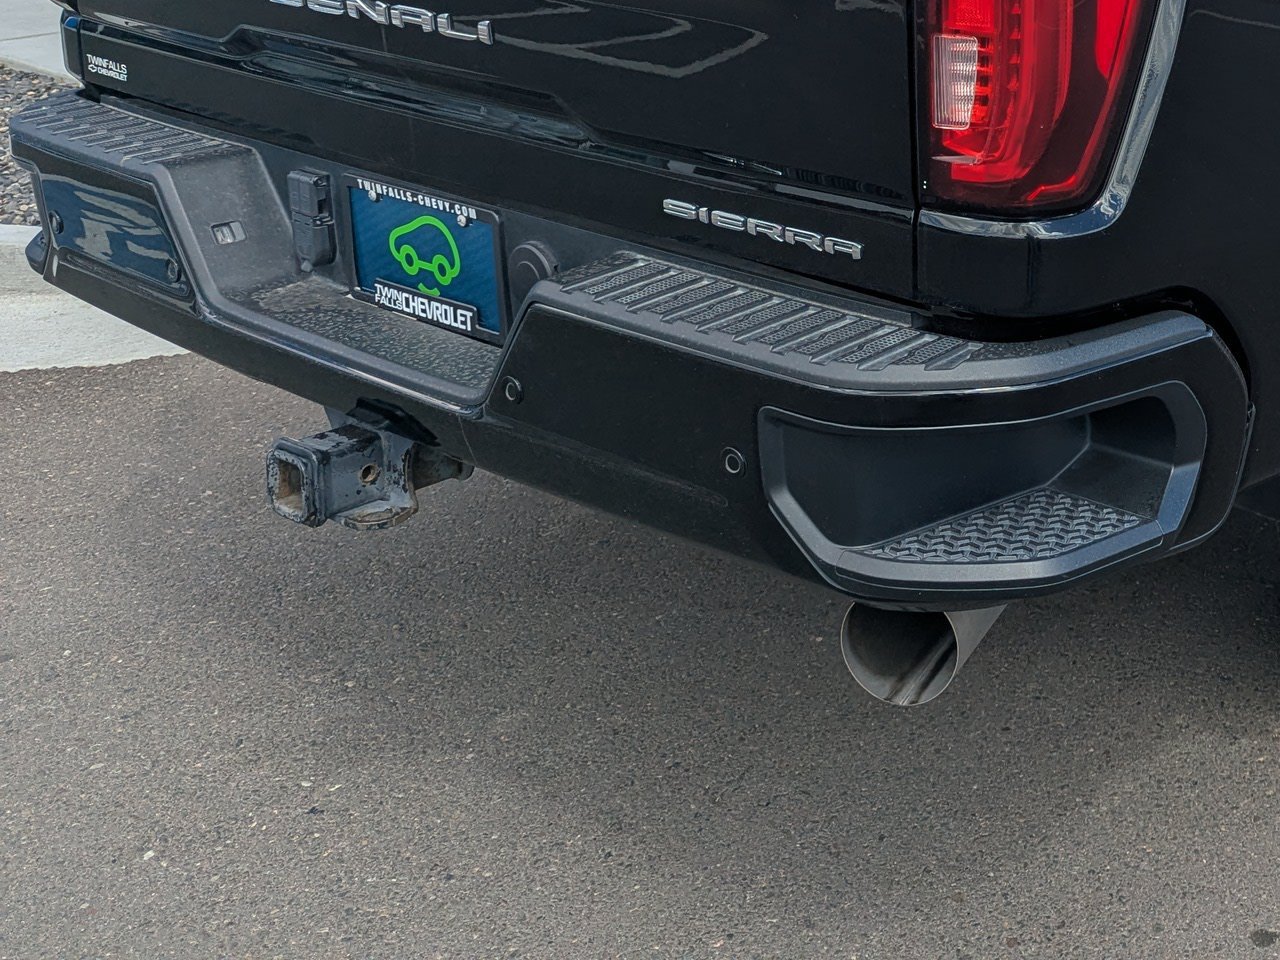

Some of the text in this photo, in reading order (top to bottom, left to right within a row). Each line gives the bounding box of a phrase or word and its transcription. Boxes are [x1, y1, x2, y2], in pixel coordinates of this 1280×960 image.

[97, 67, 128, 82] CHEVROLET
[356, 179, 477, 220] TWINFALLS-CHEVY.COM
[663, 197, 865, 261] SIERRA
[374, 283, 403, 302] TWIN
[374, 293, 403, 311] FALLS
[402, 292, 473, 332] CHEVROLET
